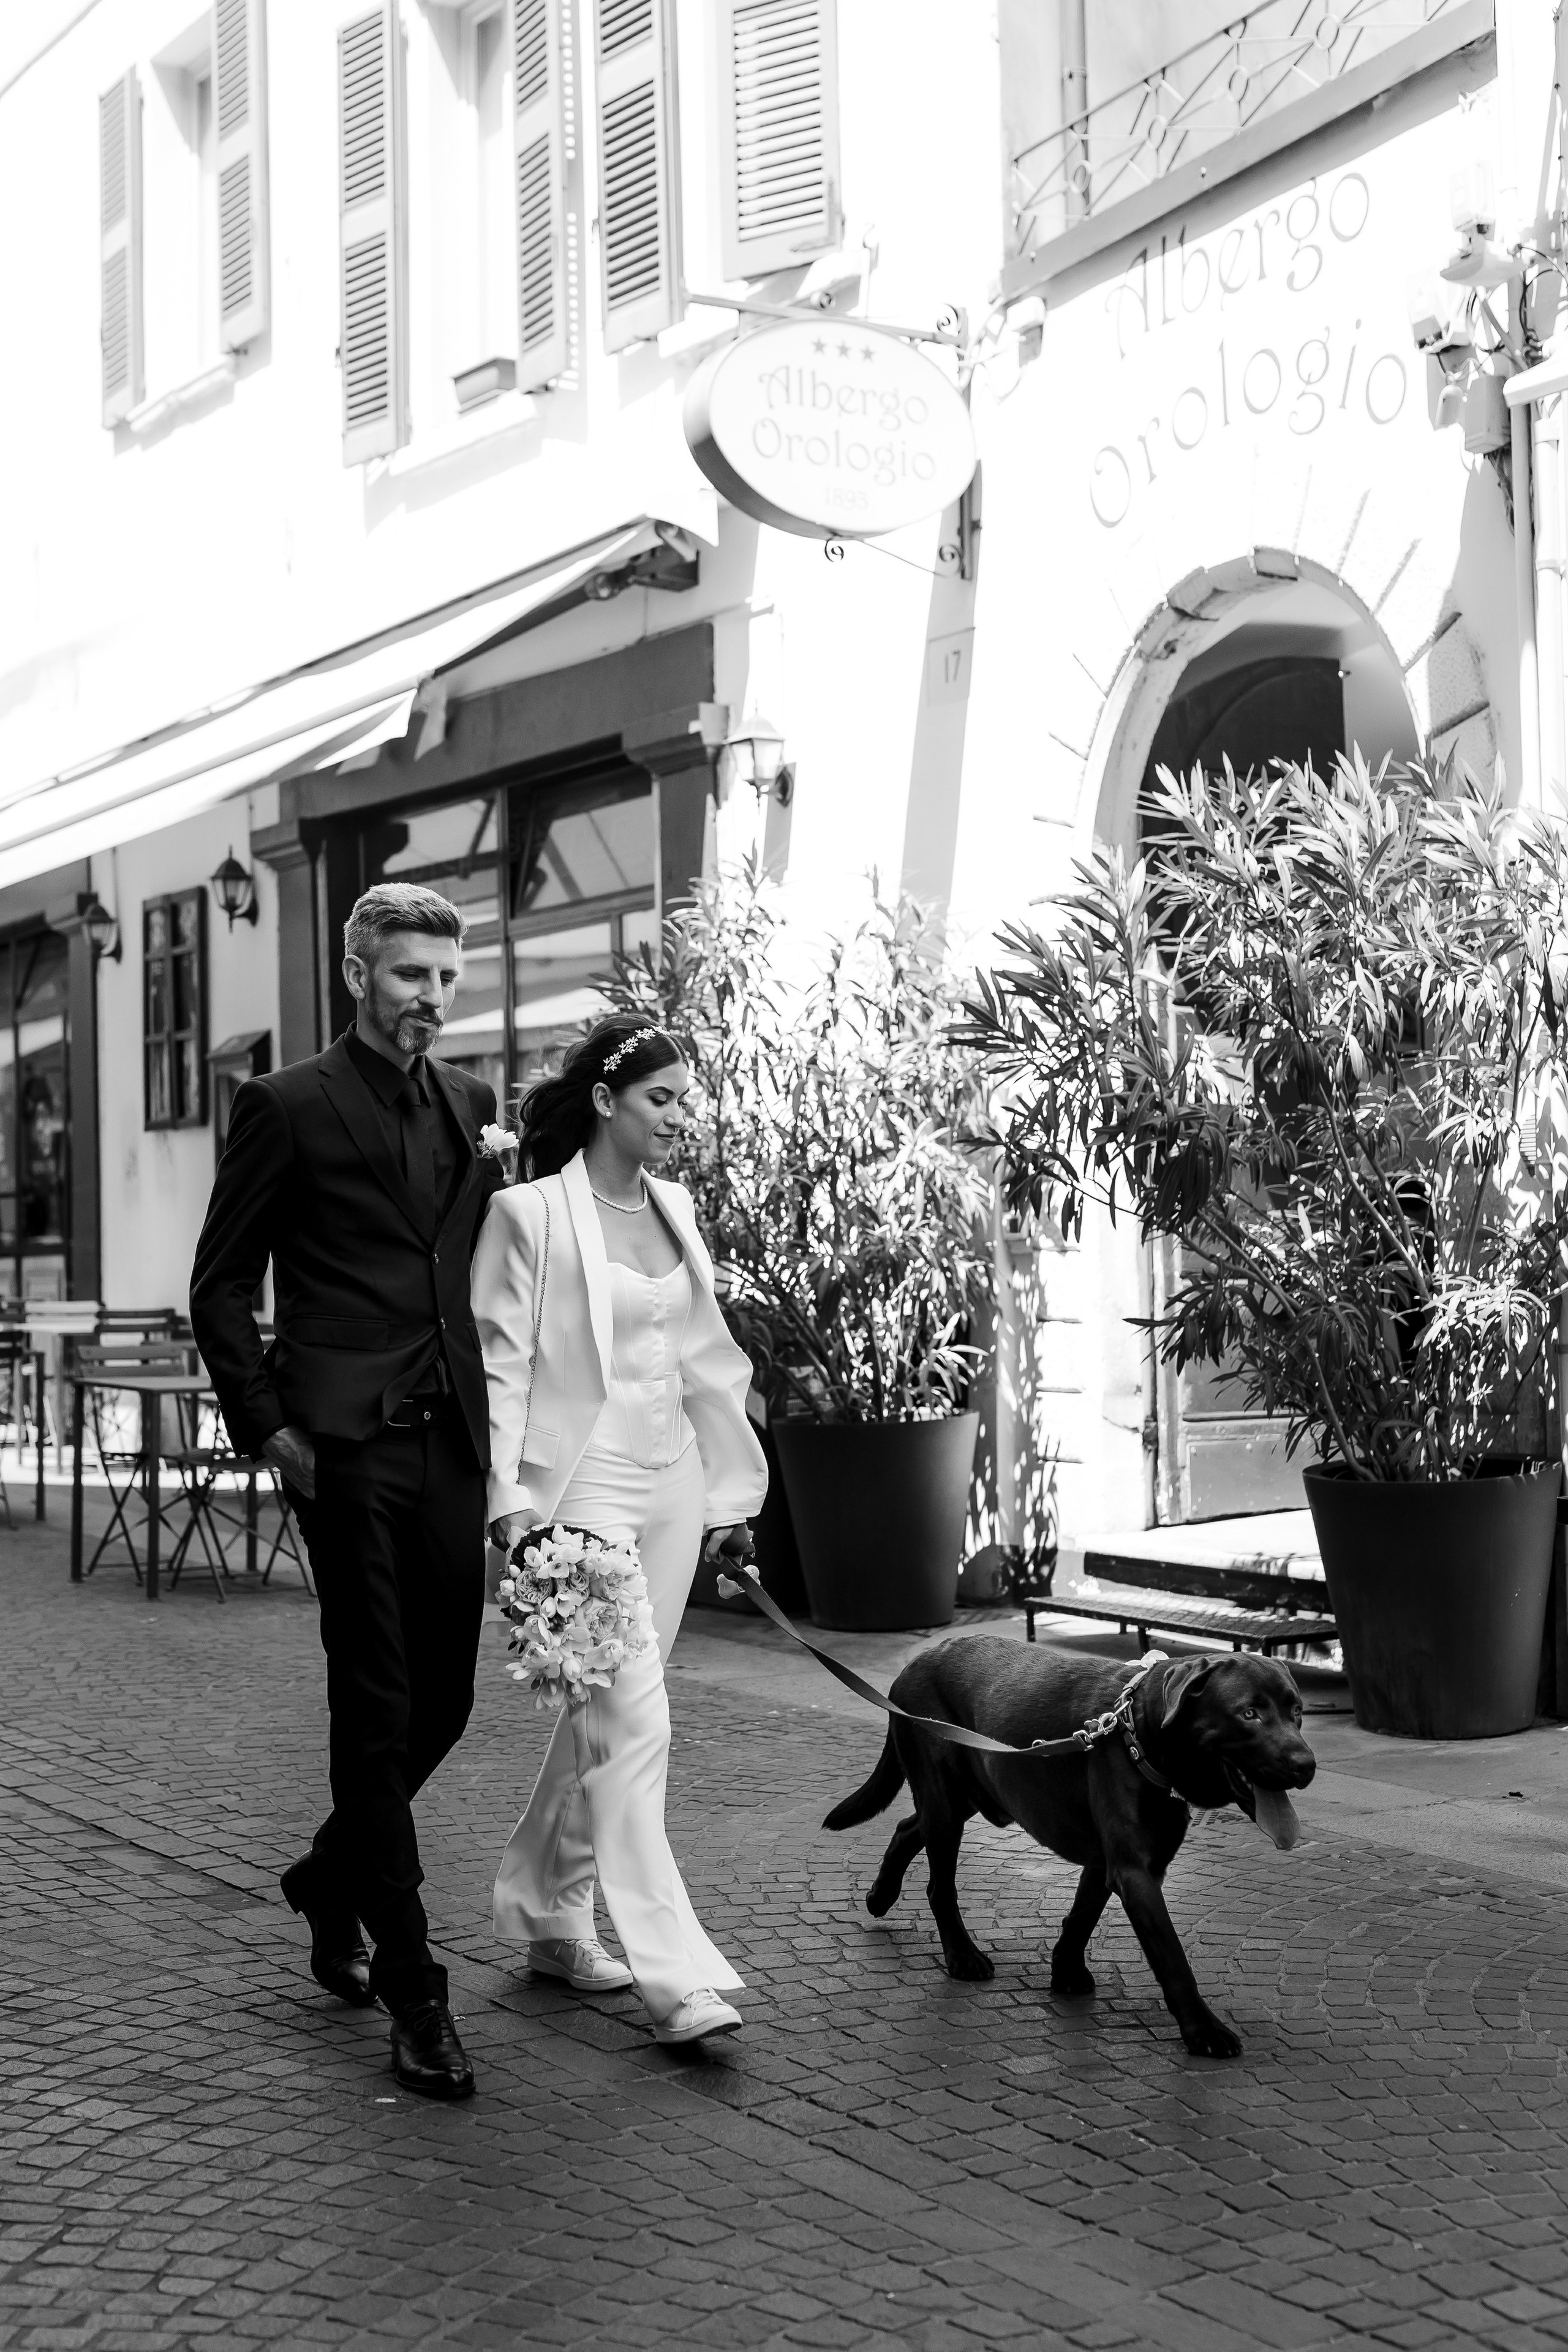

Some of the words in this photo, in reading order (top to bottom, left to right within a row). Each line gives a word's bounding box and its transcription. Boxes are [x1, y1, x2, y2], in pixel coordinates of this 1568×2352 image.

[1104, 172, 1370, 361] Albergo
[758, 365, 929, 432] Albergo
[1088, 318, 1408, 529] Orologio
[752, 417, 937, 487] Orologio
[944, 649, 961, 683] 17
